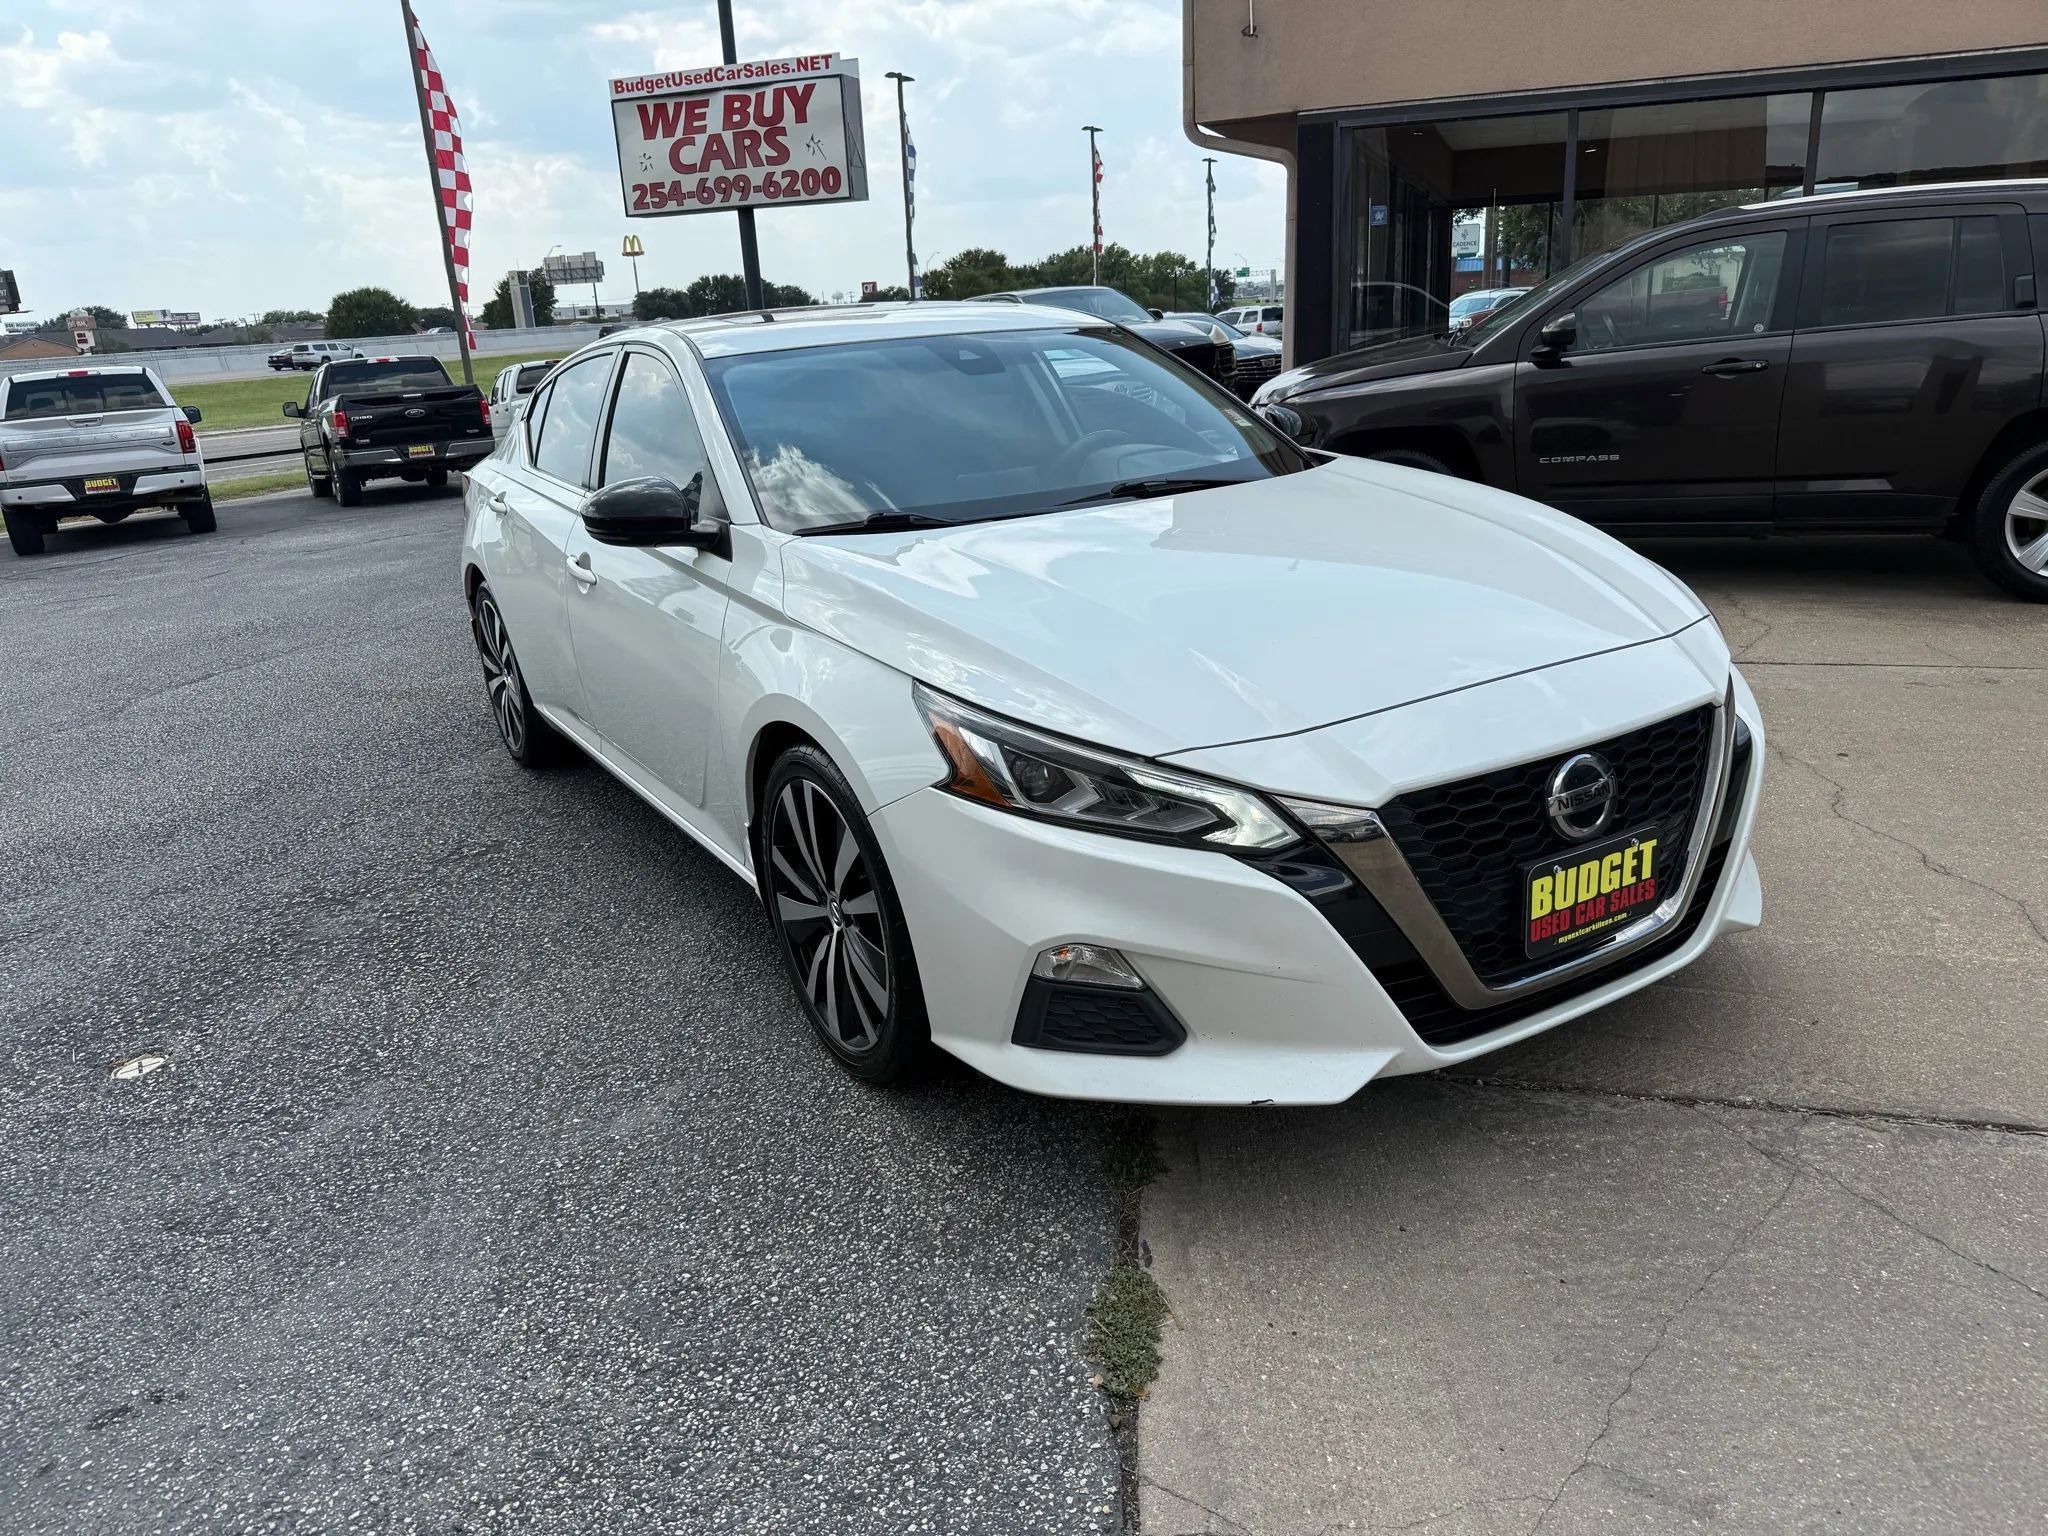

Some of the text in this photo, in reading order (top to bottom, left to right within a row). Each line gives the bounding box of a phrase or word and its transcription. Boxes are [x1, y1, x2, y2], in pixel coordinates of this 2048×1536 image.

[614, 54, 833, 94] BudgetUsedCarSales.NET
[636, 83, 816, 140] WE BUY
[669, 126, 790, 174] CARS
[632, 166, 841, 211] 254-699-6200
[863, 283, 874, 293] QT
[408, 444, 433, 453] BUDGET
[1539, 454, 1620, 464] COMPASS
[85, 478, 117, 488] BUDGET
[1557, 783, 1608, 811] NISSAN
[1531, 838, 1658, 920] BUDGET
[1530, 879, 1655, 942] USED CAR SALES
[1558, 912, 1628, 944] mynextcarkilleen.com
